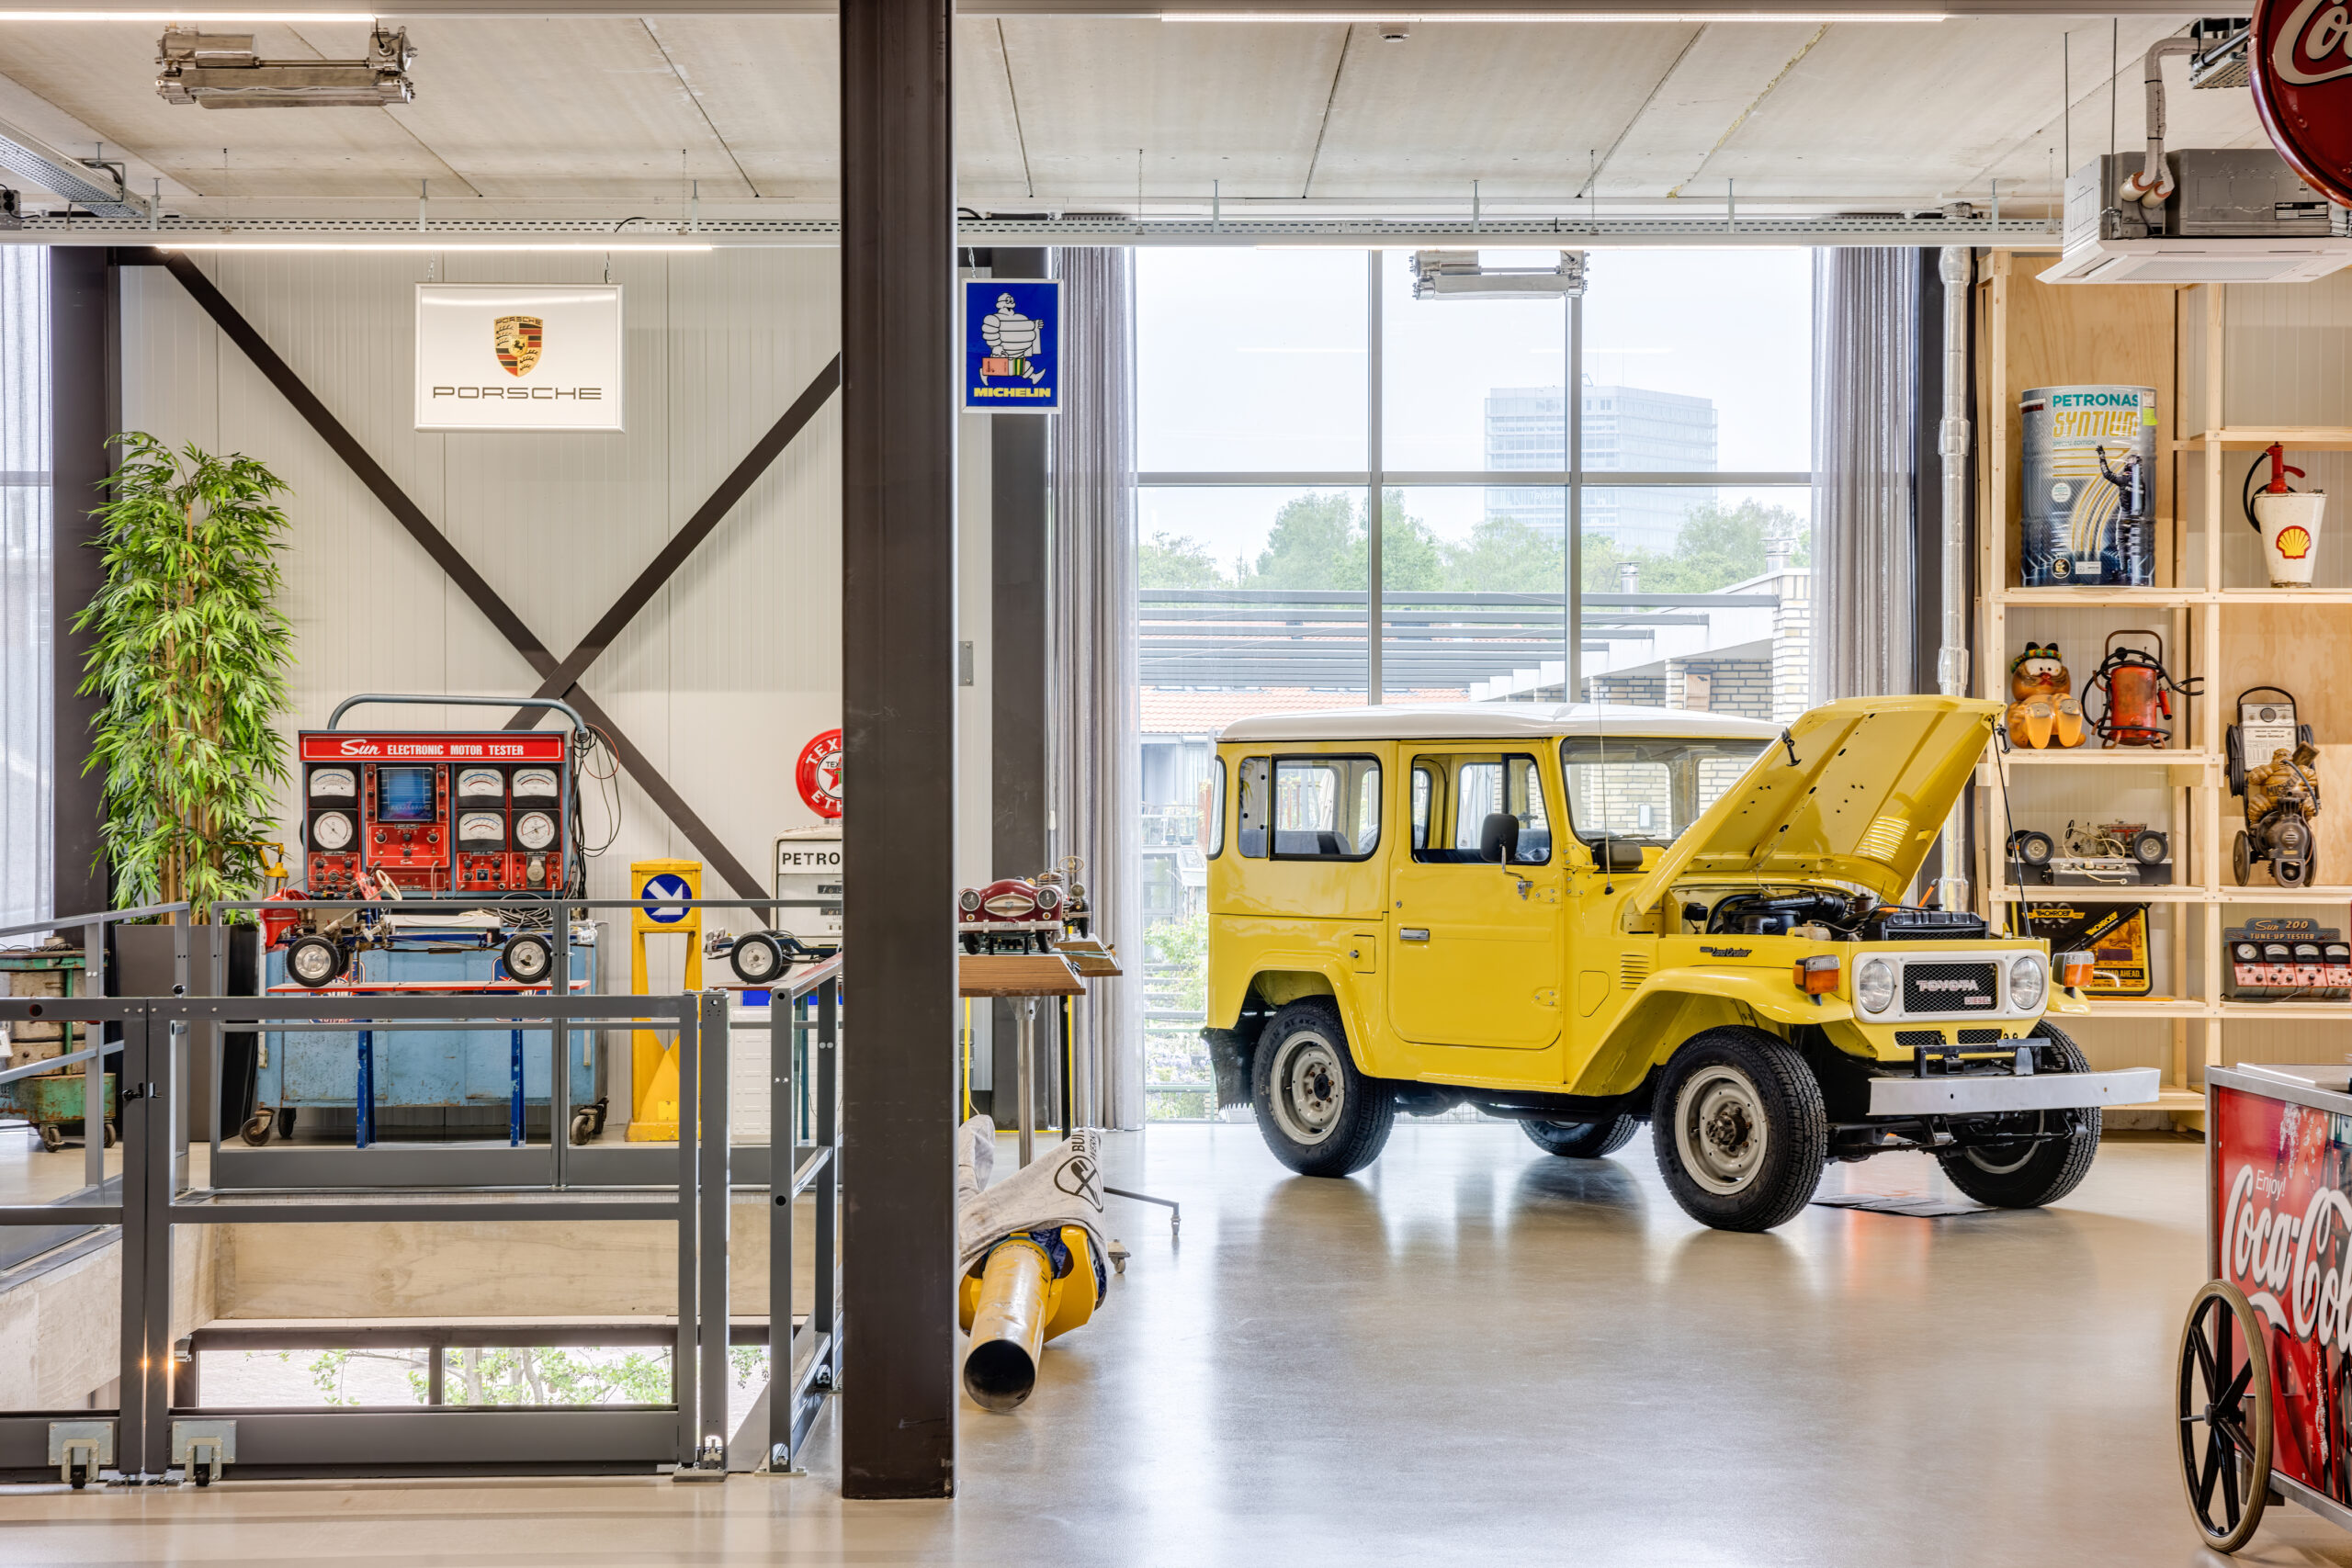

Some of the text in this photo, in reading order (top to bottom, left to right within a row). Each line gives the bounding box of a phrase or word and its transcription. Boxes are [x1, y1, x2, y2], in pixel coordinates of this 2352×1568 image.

[2272, 0, 2352, 85] Co
[496, 316, 541, 325] PORSCHE
[433, 387, 602, 400] PORSCHE
[974, 388, 1051, 398] MICHELIN
[2052, 393, 2138, 407] PETRONAS
[2052, 411, 2138, 437] SYNTIUM
[340, 739, 525, 756] Sun ELECTRONIC MOTOR TESTER
[806, 738, 842, 764] TEX
[811, 790, 842, 812] ETH
[782, 852, 841, 865] PETRO
[2255, 920, 2309, 931] Sun 200
[2120, 969, 2142, 978] AHEAD.
[1916, 979, 1979, 992] TOYOTA
[2256, 1169, 2287, 1201] Enjoy!
[2222, 1164, 2352, 1354] Coca-Col
